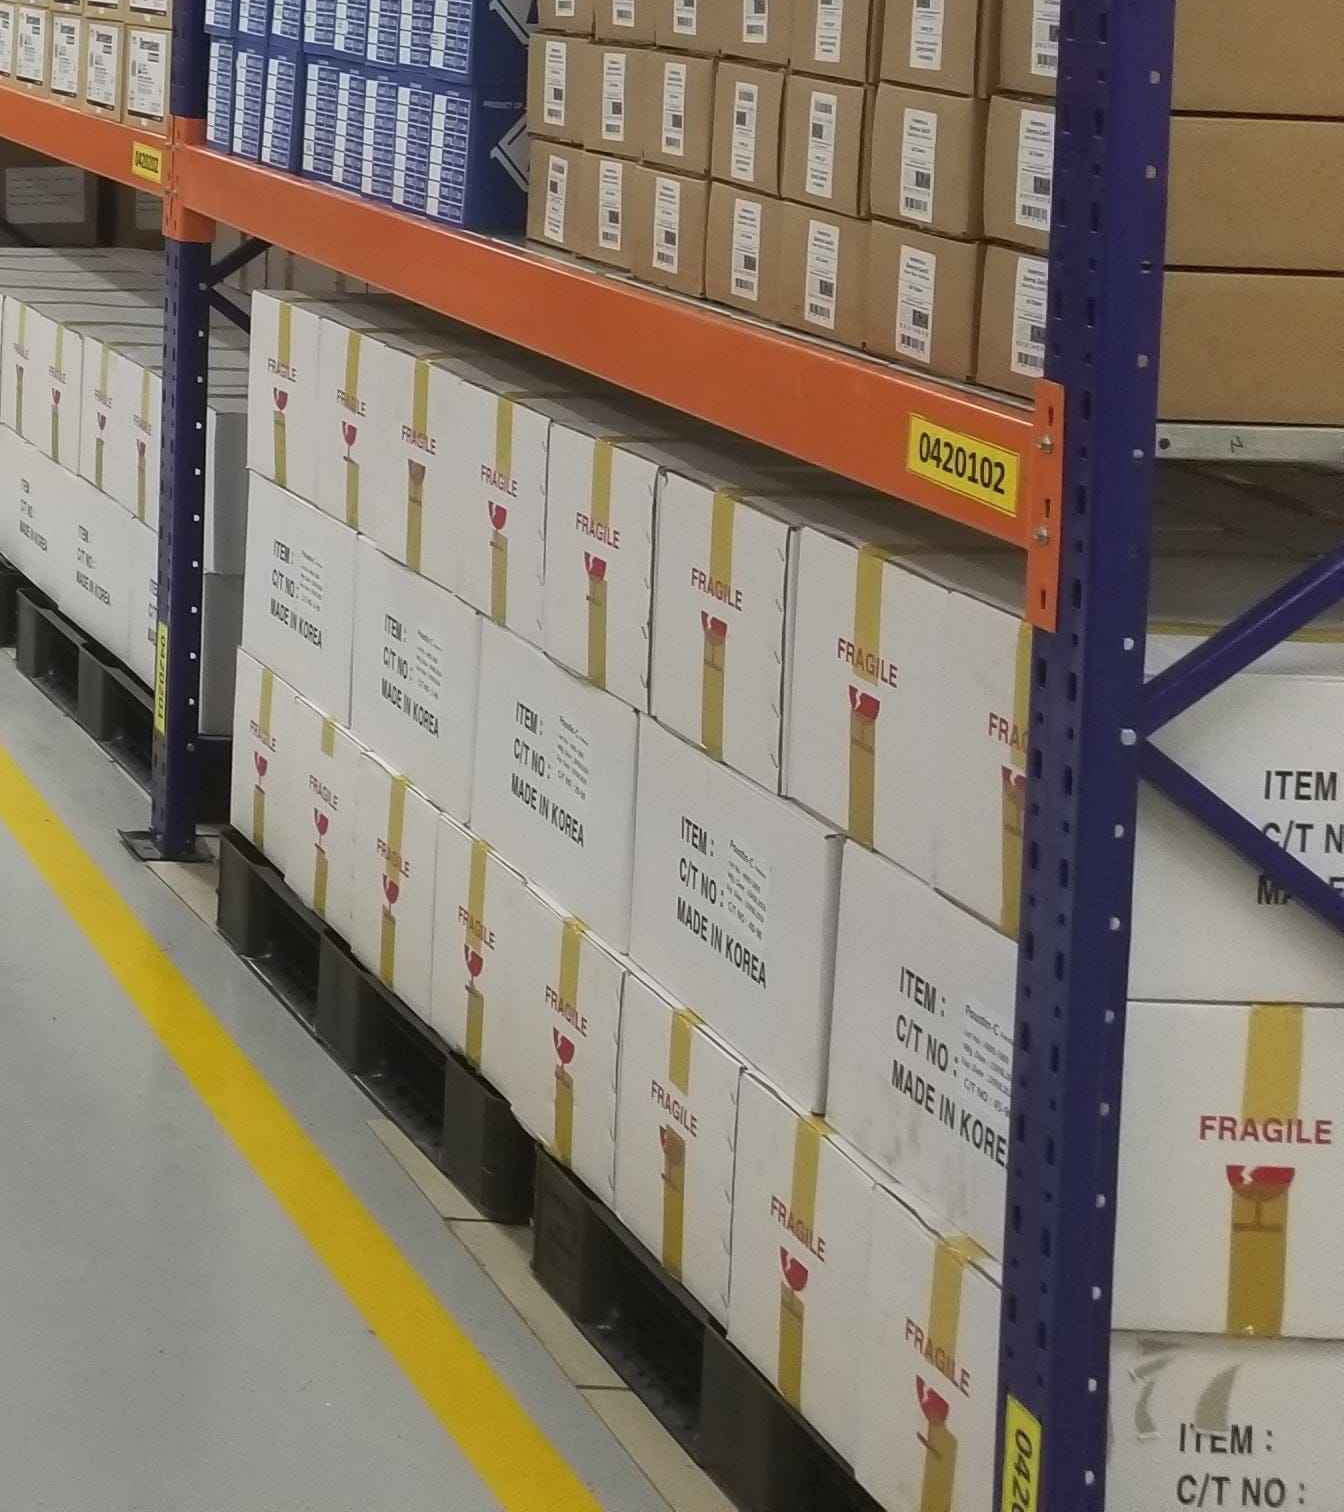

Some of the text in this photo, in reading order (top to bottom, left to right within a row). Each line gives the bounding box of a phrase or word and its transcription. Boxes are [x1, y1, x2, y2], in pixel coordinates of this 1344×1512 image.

[401, 425, 437, 455] FRAGILE
[481, 464, 518, 497] FRAGILE
[919, 431, 1006, 495] 0420102
[575, 512, 620, 549] FRAGILE
[691, 568, 743, 611] FRAGILE
[385, 613, 402, 641] ITEM
[383, 646, 397, 670] C/T
[397, 658, 408, 680] NO
[837, 638, 898, 688] FRAGILE
[381, 677, 439, 738] MADE IN KOREA
[515, 701, 538, 735] ITEM
[513, 738, 530, 768] C/T
[532, 751, 545, 777] NO
[1264, 770, 1337, 801] ITEM
[511, 773, 585, 848] MADE IN KOREA
[681, 815, 708, 856] ITEM
[679, 857, 698, 890] C/T
[701, 872, 717, 904] NO
[677, 896, 767, 989] MADE IN KOREA
[545, 985, 588, 1037] FRAGILE
[899, 966, 936, 1014] ITEM
[896, 1014, 923, 1054] C/T
[926, 1034, 949, 1072] NO
[651, 1079, 698, 1137] FRAGILE
[891, 1059, 1010, 1169] MADE IN KORE
[1199, 1115, 1333, 1146] FRAGILE
[770, 1195, 826, 1262] FRAGILE
[905, 1317, 971, 1398] FRAGILE
[1178, 1423, 1253, 1454] ITEM
[1176, 1474, 1231, 1506] C/T
[1241, 1476, 1286, 1507] NO
